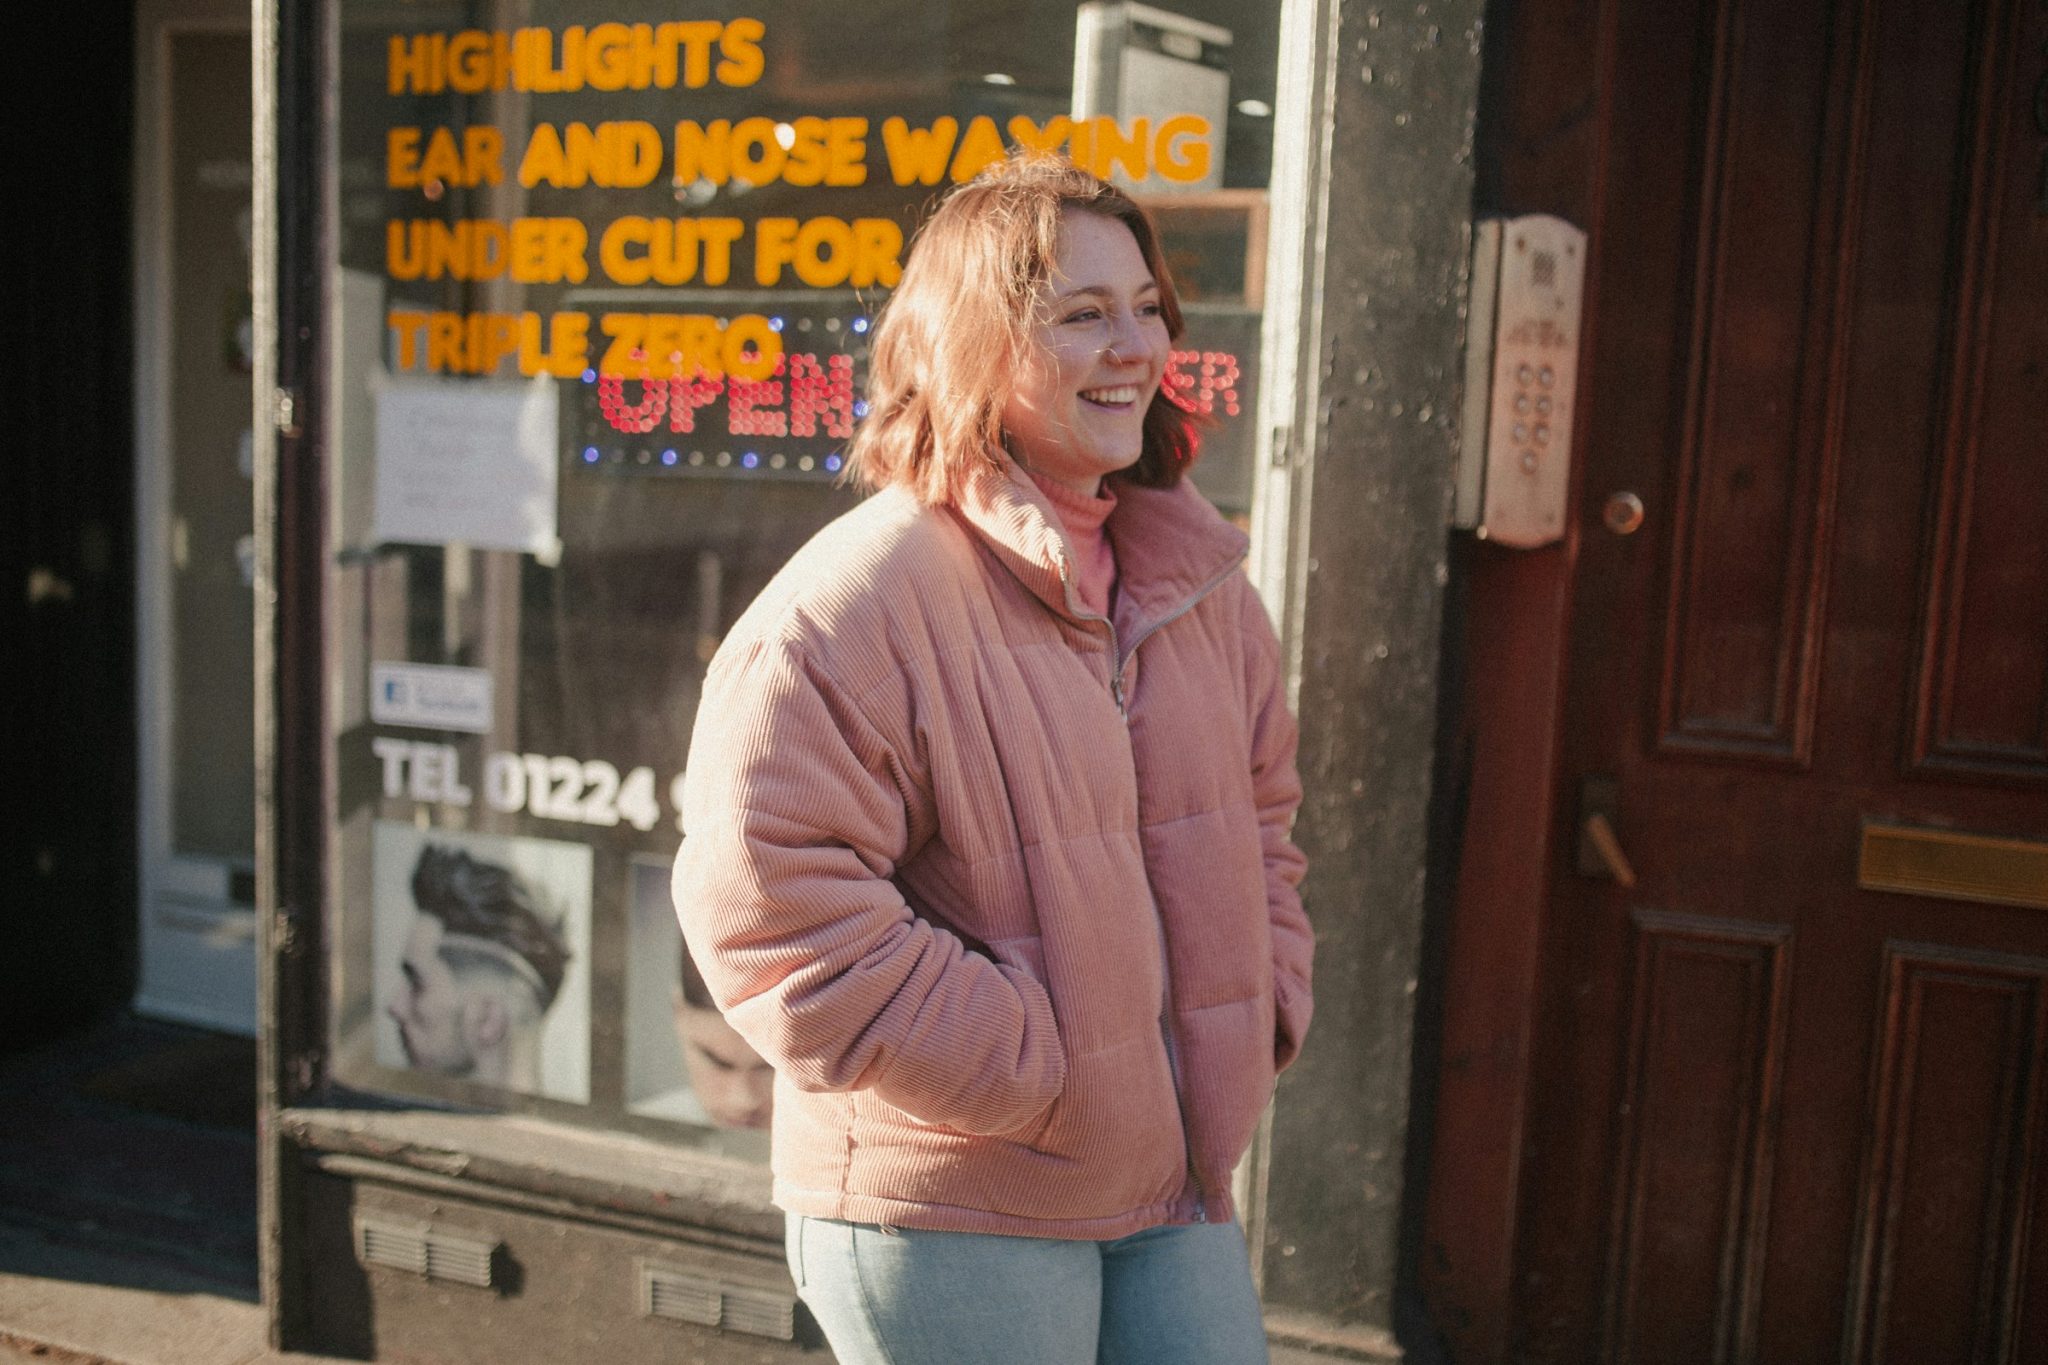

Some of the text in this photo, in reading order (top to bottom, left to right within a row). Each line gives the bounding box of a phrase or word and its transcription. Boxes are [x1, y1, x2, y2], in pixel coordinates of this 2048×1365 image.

[388, 17, 766, 94] HIGHLIGHTS
[387, 114, 1212, 189] EAR AND NOSE WAXING
[387, 215, 904, 288] UNDER CUT FOR
[387, 310, 783, 382] TRIPLE ZERO
[598, 347, 854, 438] OPEN
[485, 750, 660, 832] 01224
